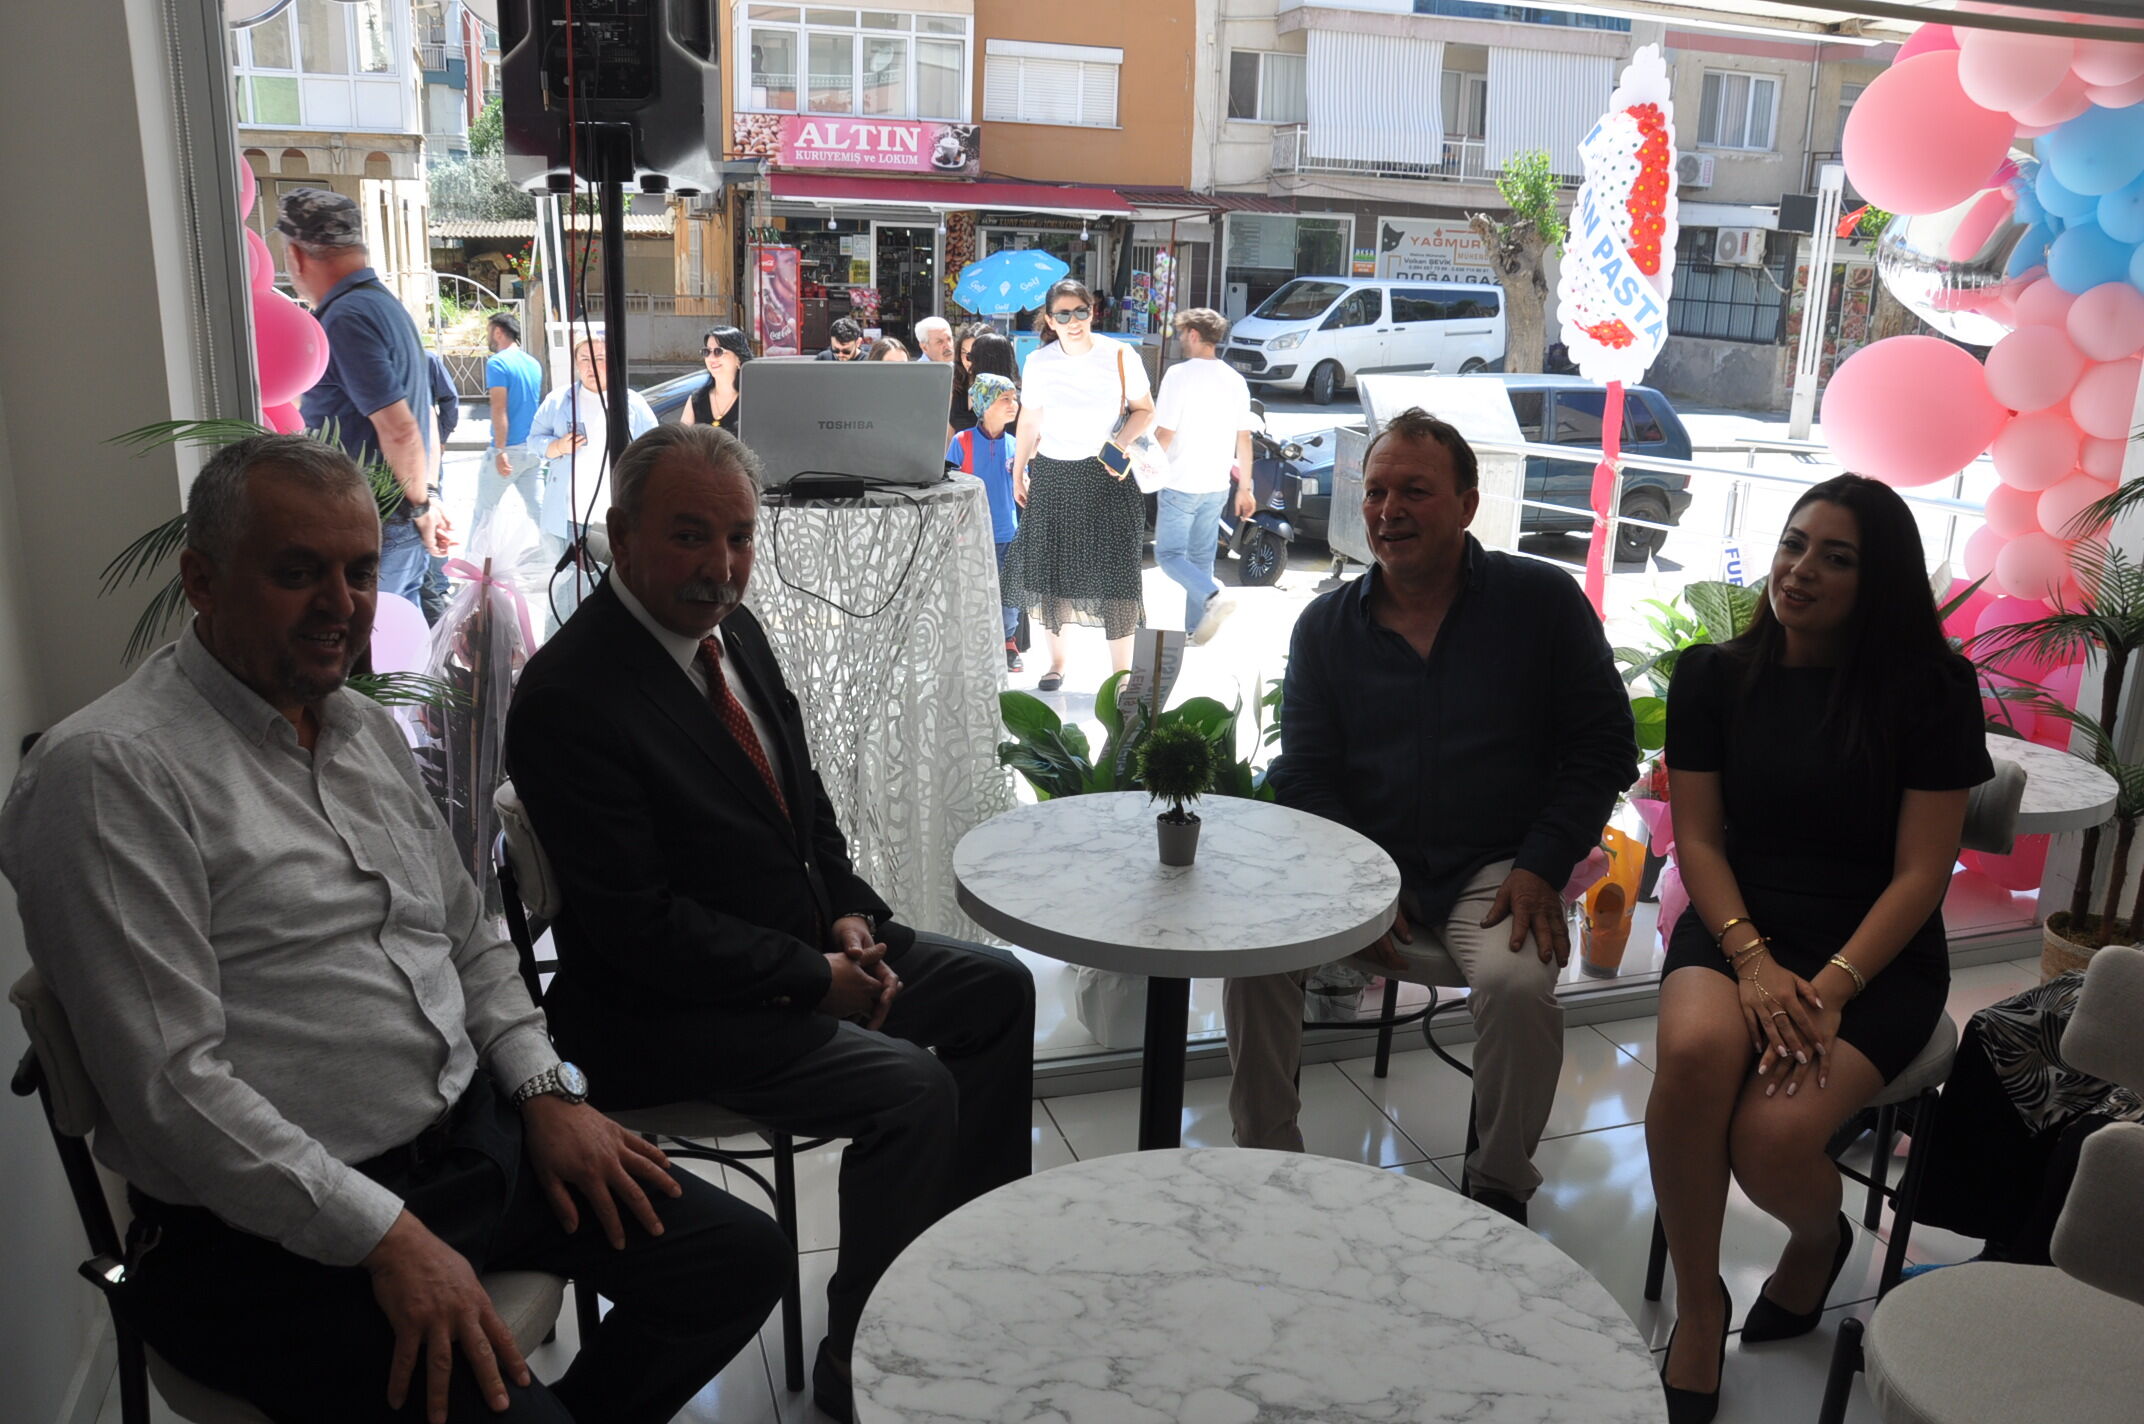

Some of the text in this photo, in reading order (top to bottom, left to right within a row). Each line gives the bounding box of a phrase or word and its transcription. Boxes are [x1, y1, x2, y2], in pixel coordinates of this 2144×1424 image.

[793, 122, 922, 153] ALTIN
[864, 154, 876, 163] ve
[878, 153, 918, 165] LOKUM
[1019, 276, 1040, 291] Golf
[1592, 233, 1664, 350] PASTA
[817, 420, 874, 430] TOSHIBA
